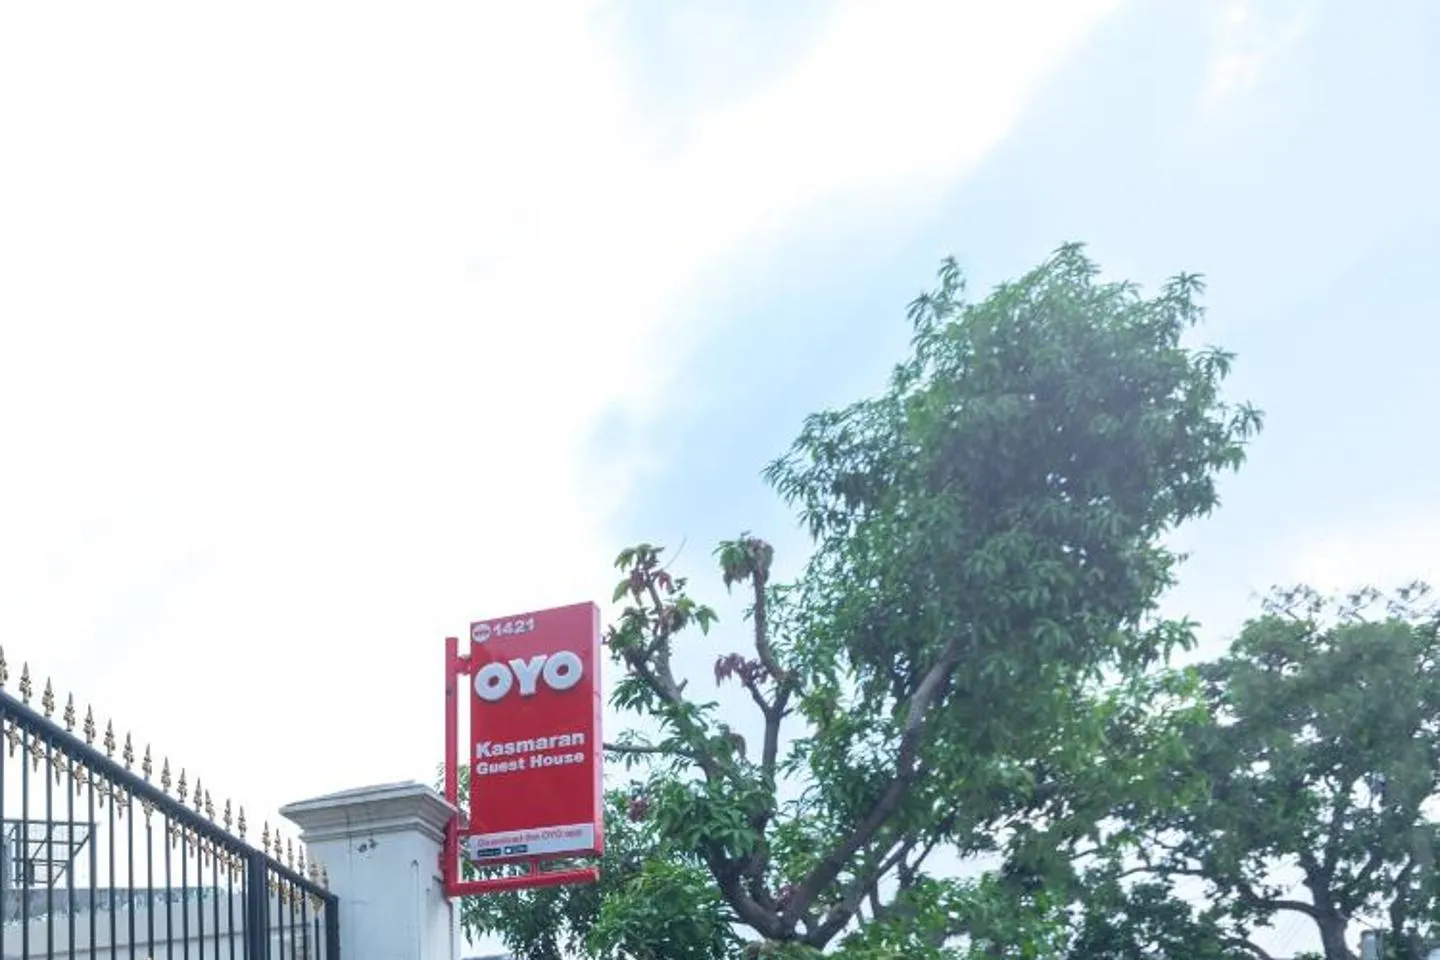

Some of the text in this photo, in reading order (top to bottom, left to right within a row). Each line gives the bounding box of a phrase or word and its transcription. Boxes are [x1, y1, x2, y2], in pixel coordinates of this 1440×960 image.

[492, 618, 535, 636] 1421
[474, 651, 583, 701] OYO
[476, 732, 585, 759] Kasmaran
[476, 752, 585, 775] Guest House
